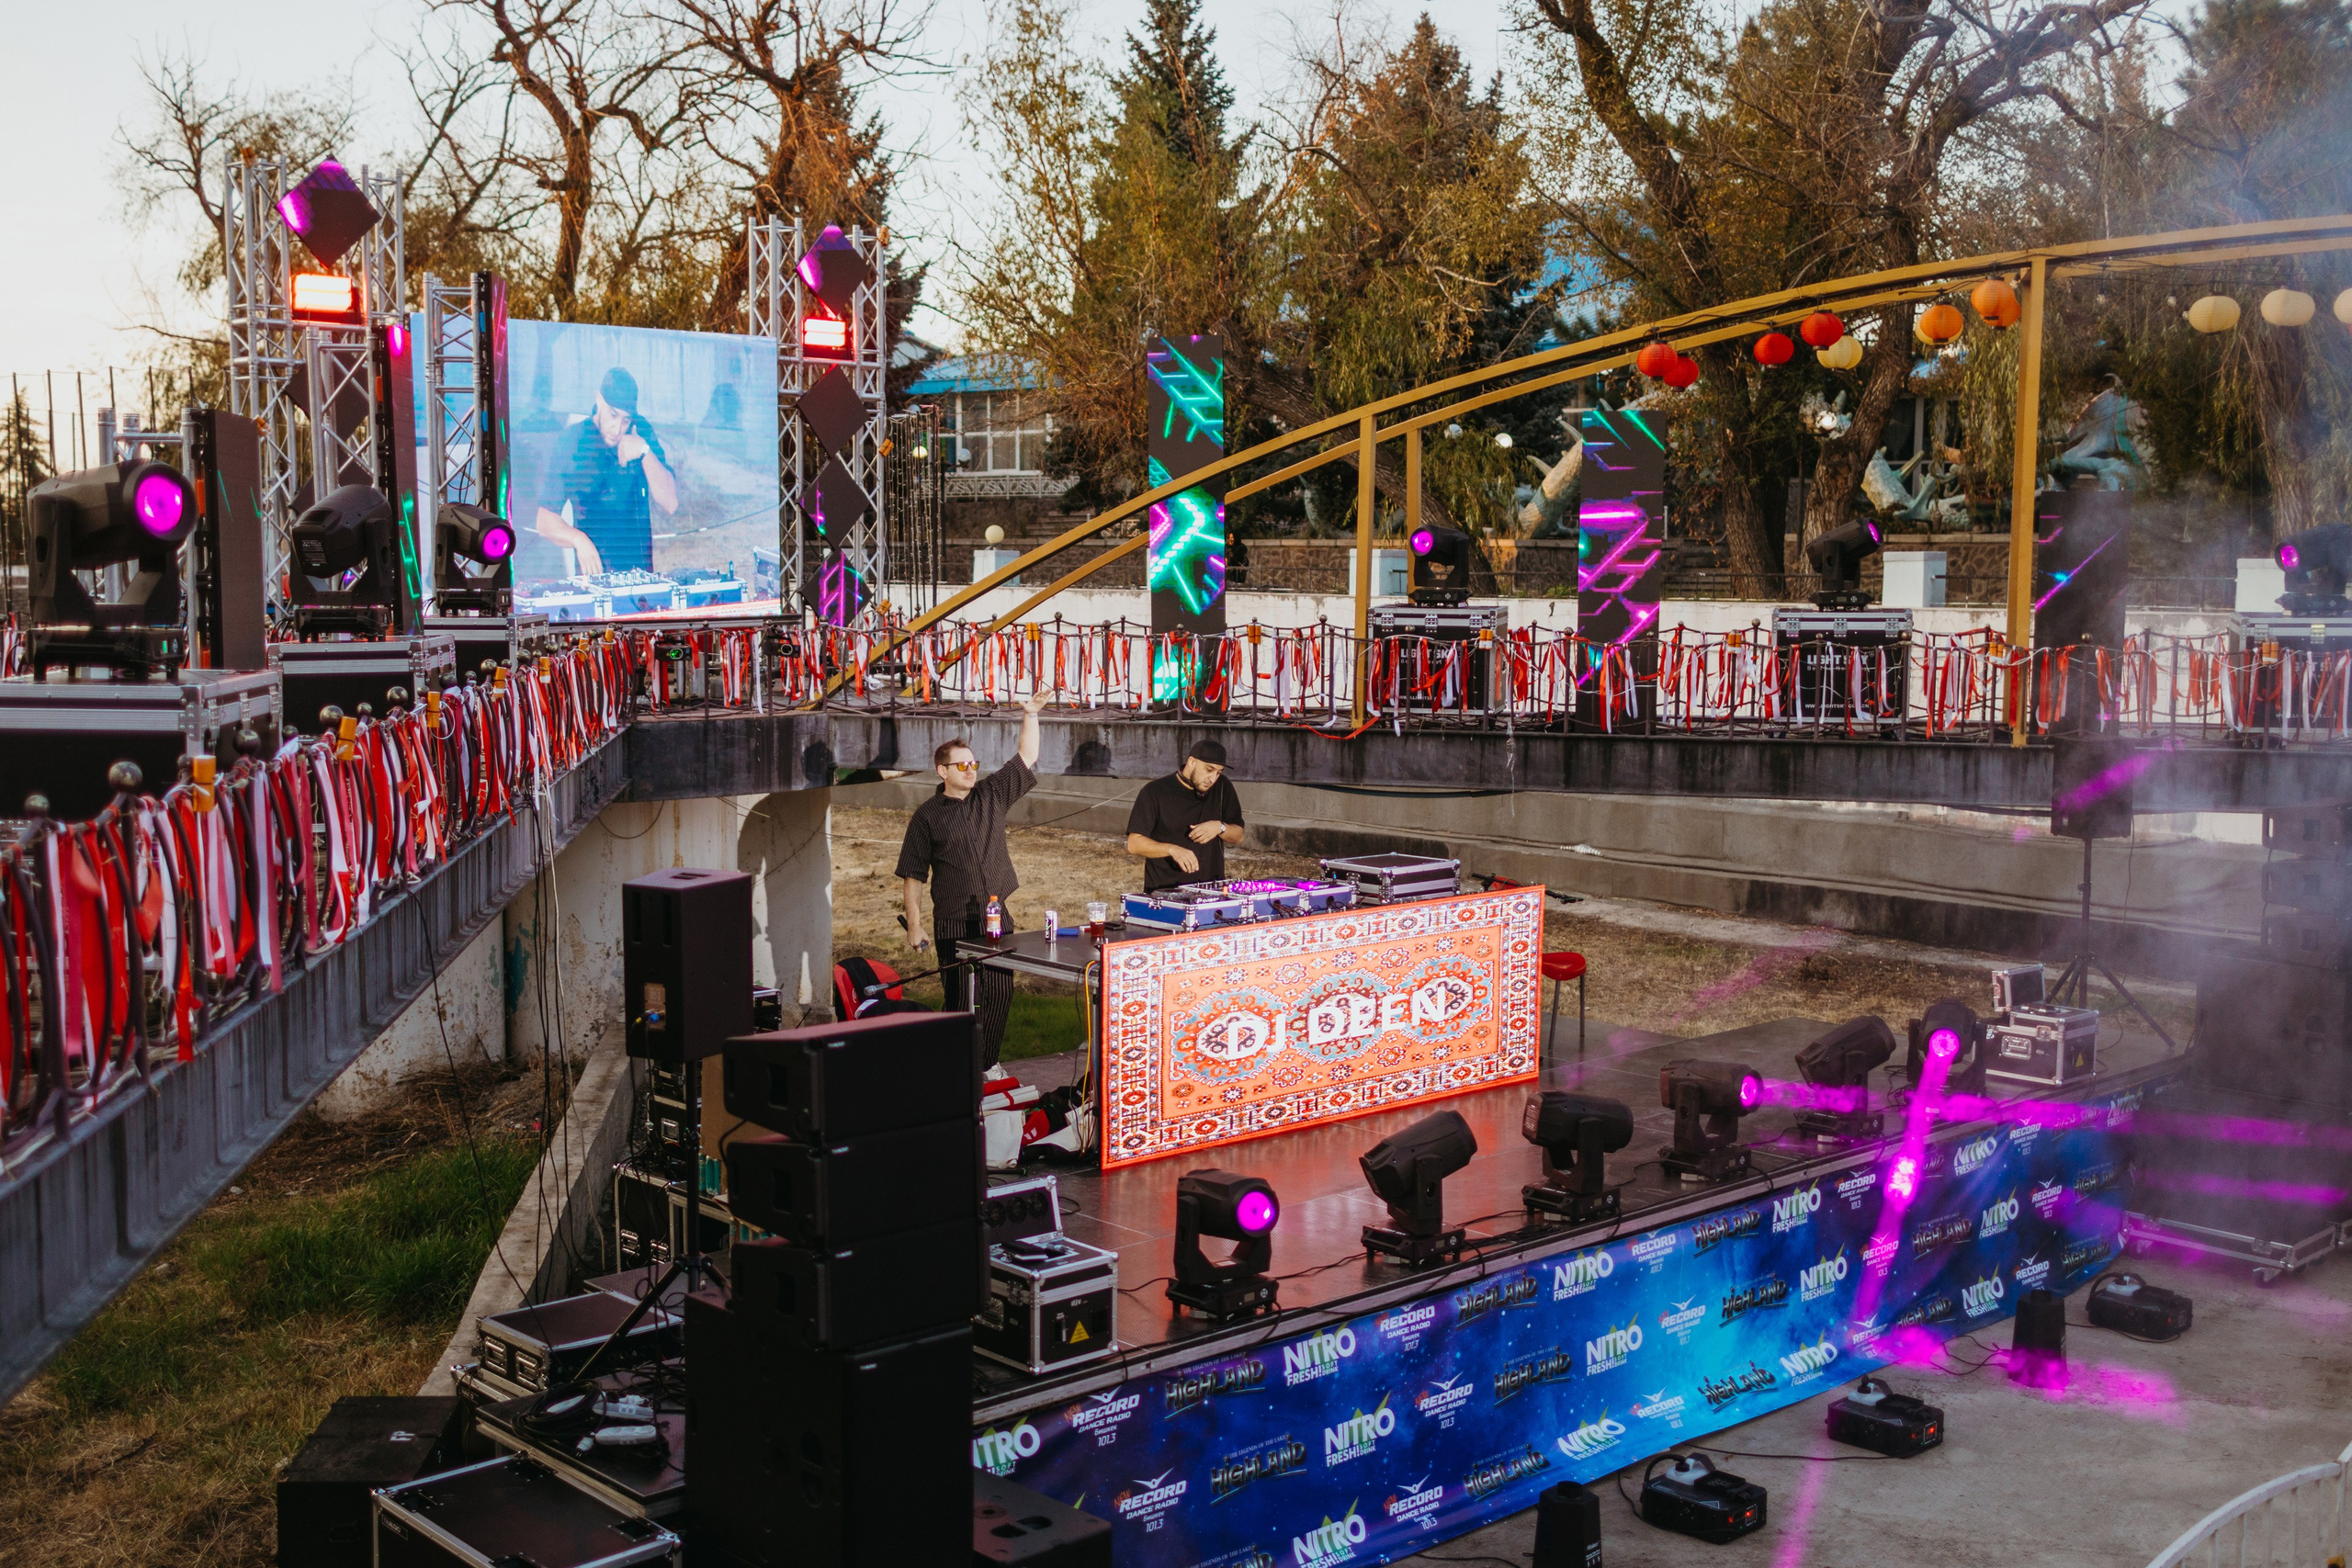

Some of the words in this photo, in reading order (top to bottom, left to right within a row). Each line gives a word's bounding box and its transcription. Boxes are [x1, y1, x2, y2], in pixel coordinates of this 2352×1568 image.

[1401, 649, 1431, 658] LIGT
[1843, 655, 1868, 664] SY
[1227, 1014, 1286, 1056] DJ
[1307, 987, 1446, 1045] DEEN
[2009, 1122, 2041, 1139] RECORD
[1954, 1136, 1997, 1167] NITRO
[1838, 1174, 1876, 1193] RECORD
[2031, 1184, 2063, 1203] RECORD
[1773, 1188, 1821, 1223] NITRO
[1982, 1198, 2019, 1228] NITRO
[1691, 1204, 1761, 1249] HIGHLAND
[1772, 1216, 1796, 1234] FRESH!
[1913, 1213, 1973, 1253] HIGHLAND
[1632, 1234, 1676, 1257] RECORD
[1862, 1240, 1899, 1261] RECORD
[1554, 1252, 1613, 1290] NITRO
[1800, 1256, 1848, 1292] NITRO
[2016, 1260, 2050, 1280] RECORD
[1456, 1269, 1538, 1321] HIGHLAND
[1554, 1284, 1583, 1302] FRESH!
[1722, 1272, 1787, 1319] HIGHLAND
[1962, 1277, 2004, 1310] NITRO
[1380, 1305, 1435, 1332] RECORD
[1387, 1326, 1409, 1338] DANCE
[1410, 1321, 1430, 1332] RADIO
[1661, 1304, 1706, 1328] RECORD
[1283, 1327, 1356, 1374] NITRO
[1586, 1325, 1643, 1365] NITRO
[1322, 1359, 1339, 1371] SOFT
[1322, 1366, 1339, 1377] DRINK
[1494, 1345, 1571, 1398] HIGHLAND
[1587, 1359, 1614, 1377] FRESH!
[1780, 1342, 1838, 1377] NITRO
[1165, 1352, 1266, 1410] HIGHLAND
[1286, 1364, 1322, 1387] FRESH!
[1697, 1360, 1777, 1405] HIGHLAND
[1071, 1393, 1140, 1428] RECORD
[1419, 1383, 1474, 1411] RECORD
[1425, 1405, 1447, 1417] DANCE
[1447, 1398, 1466, 1410] RADIO
[1637, 1395, 1685, 1418] RECORD
[1079, 1418, 1105, 1433] DANCE
[1106, 1411, 1131, 1425] RADIO
[1324, 1407, 1396, 1455] NITRO
[973, 1424, 1040, 1469] ITRO
[1098, 1433, 1116, 1447] 101.3
[1360, 1439, 1375, 1450] SOFT
[1360, 1446, 1376, 1456] DRINK
[1557, 1418, 1626, 1457] NITRO
[1211, 1433, 1306, 1495] HIGHLAND
[1326, 1445, 1360, 1468] FRESH!
[1463, 1443, 1551, 1497] HIGHLAND
[1118, 1479, 1188, 1514] RECORD
[1125, 1502, 1153, 1520] DANCE
[1155, 1496, 1179, 1514] RADIO
[1388, 1485, 1444, 1517] RECORD
[1396, 1509, 1419, 1522] DANCE
[1419, 1501, 1439, 1516] RADIO
[1145, 1517, 1164, 1534] 101.3
[1293, 1514, 1366, 1565] NITRO
